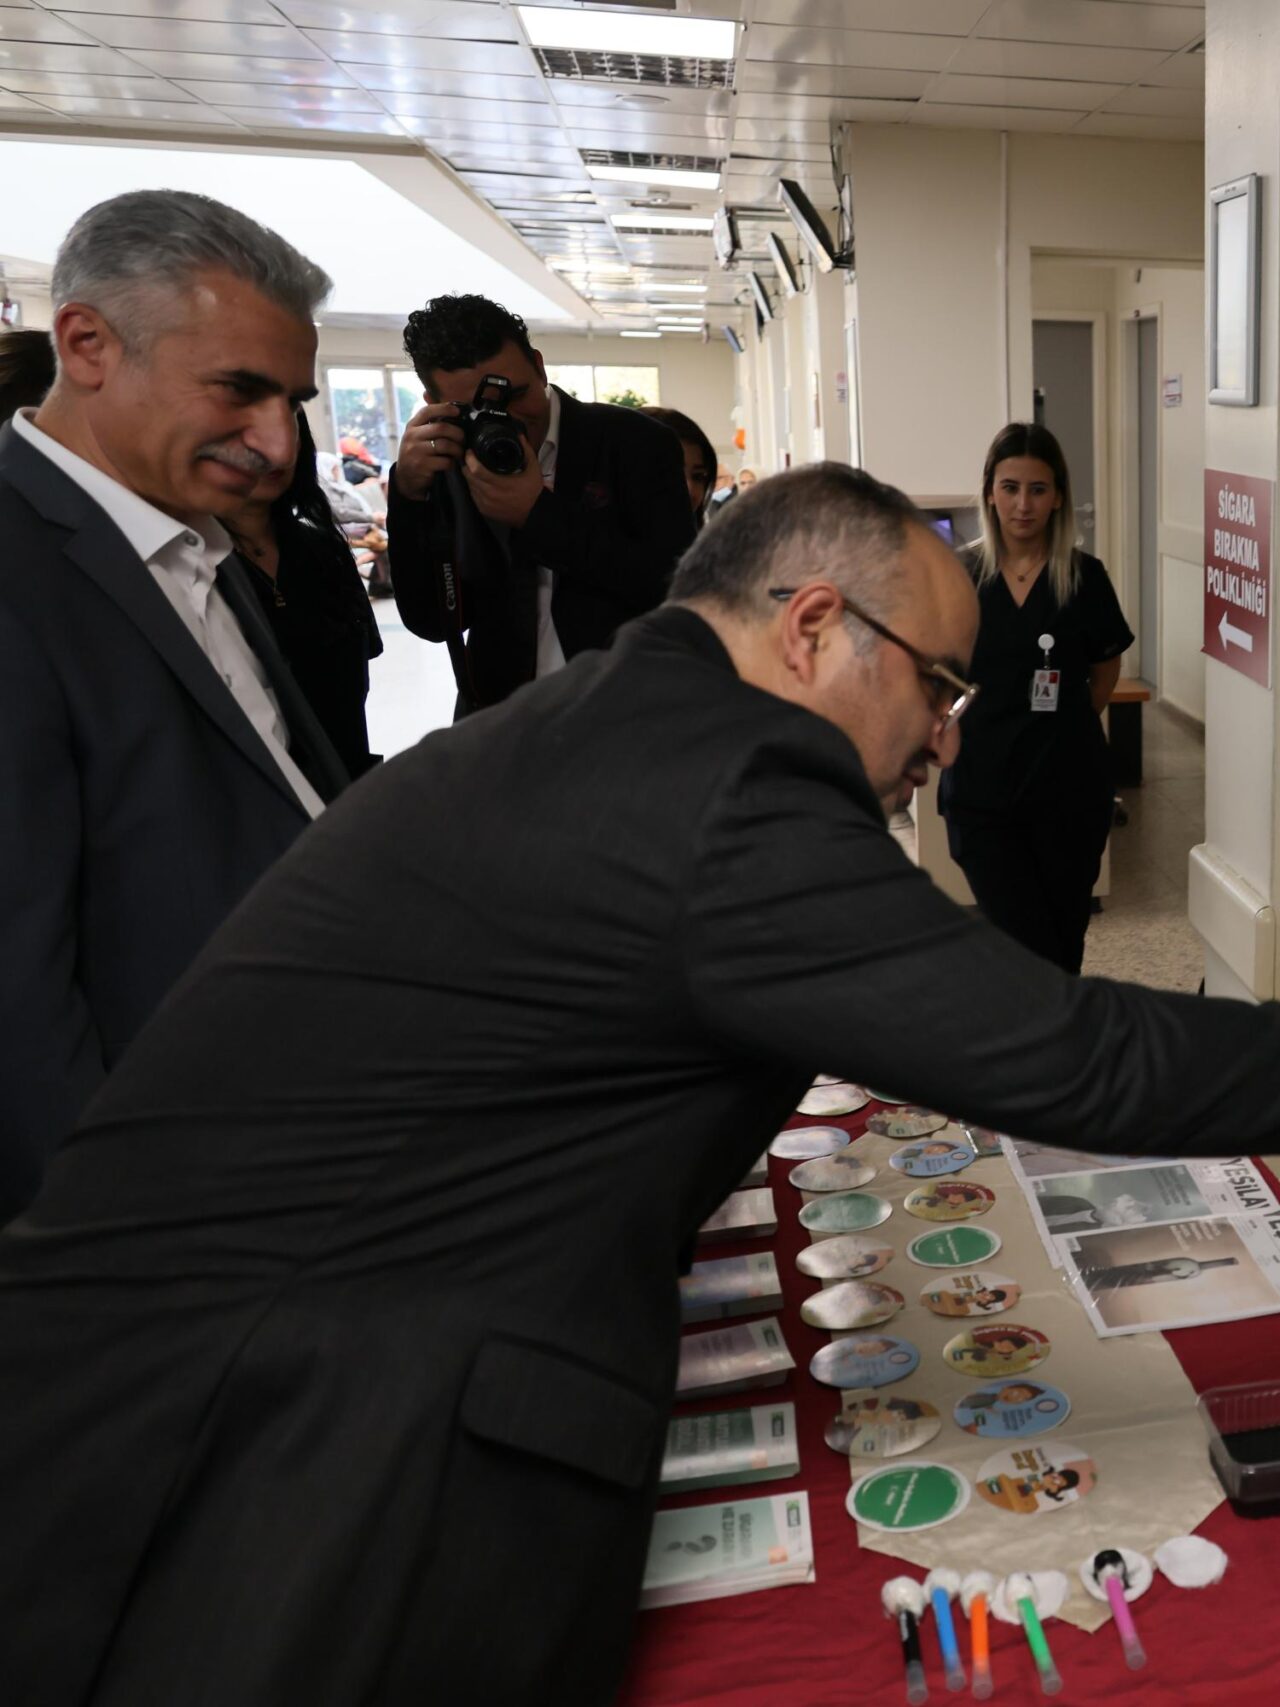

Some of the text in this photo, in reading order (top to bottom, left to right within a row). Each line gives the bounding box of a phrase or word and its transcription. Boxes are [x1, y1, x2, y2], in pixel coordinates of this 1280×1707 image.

[1218, 484, 1256, 527] SİGARA
[1214, 529, 1259, 571] BIRAKMA
[443, 563, 456, 610] Canon
[1207, 566, 1266, 617] POLİKLİNİĞİ
